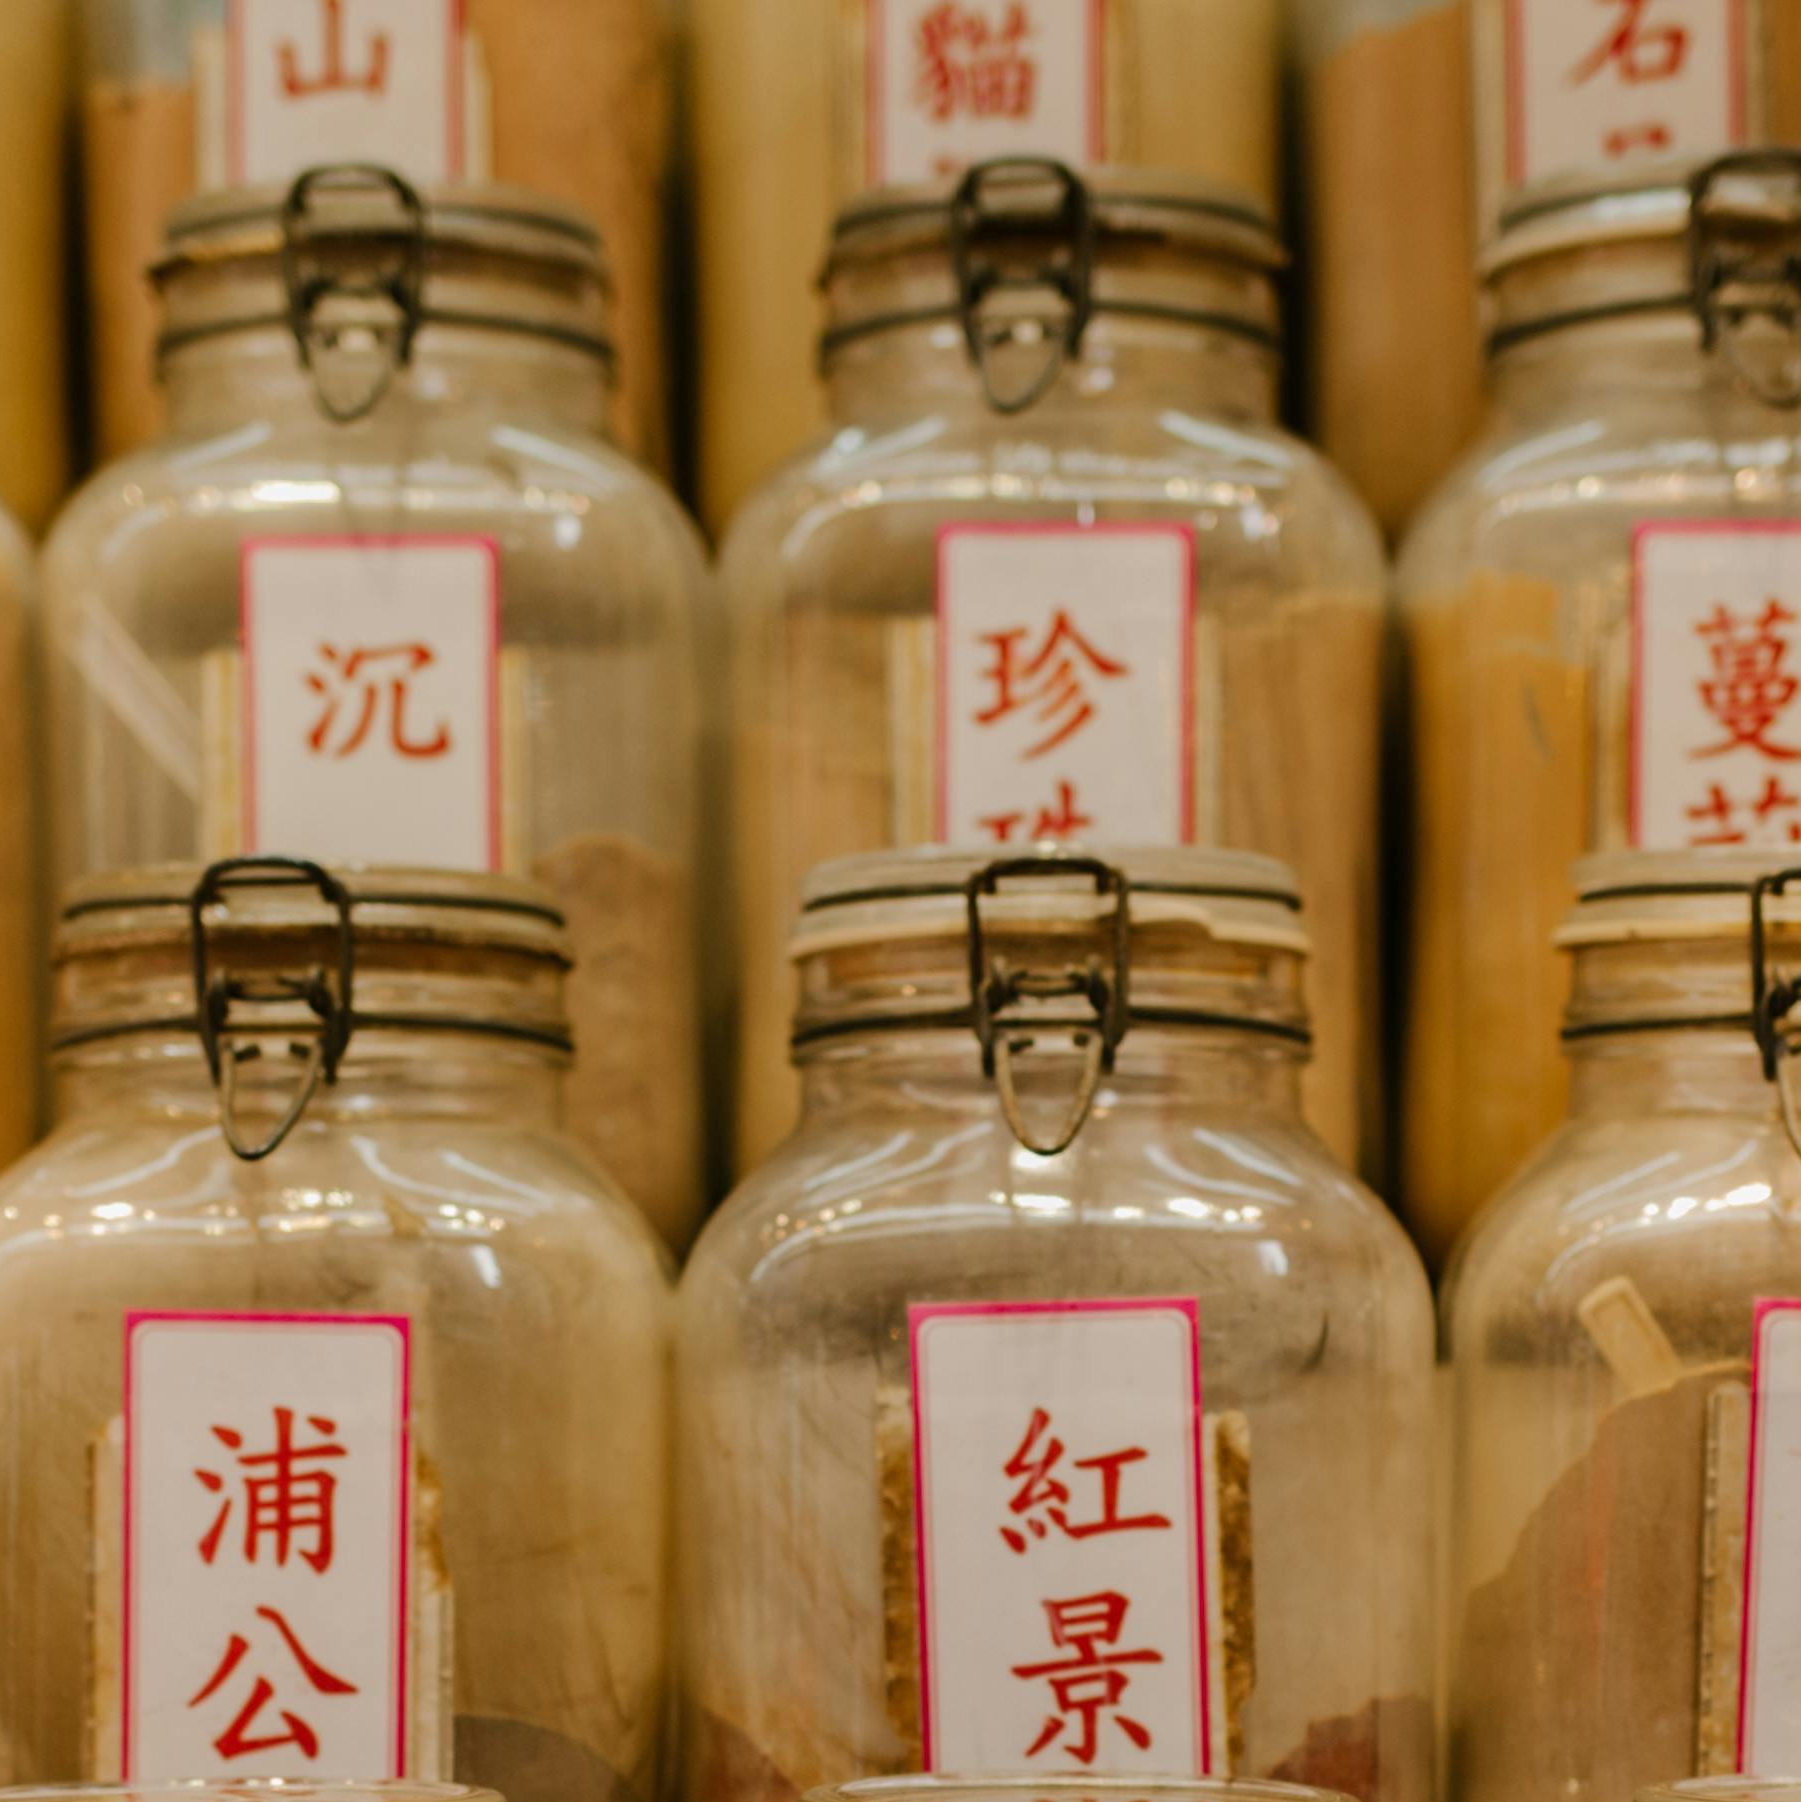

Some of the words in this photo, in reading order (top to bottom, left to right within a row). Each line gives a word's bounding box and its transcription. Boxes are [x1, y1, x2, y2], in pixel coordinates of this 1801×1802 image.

[278, 0, 390, 100] 山
[916, 4, 1036, 178] 貓
[1568, 0, 1690, 155] 石
[308, 644, 451, 760] 沉
[191, 1407, 357, 1760] 浦公
[1000, 1409, 1171, 1764] 紅景
